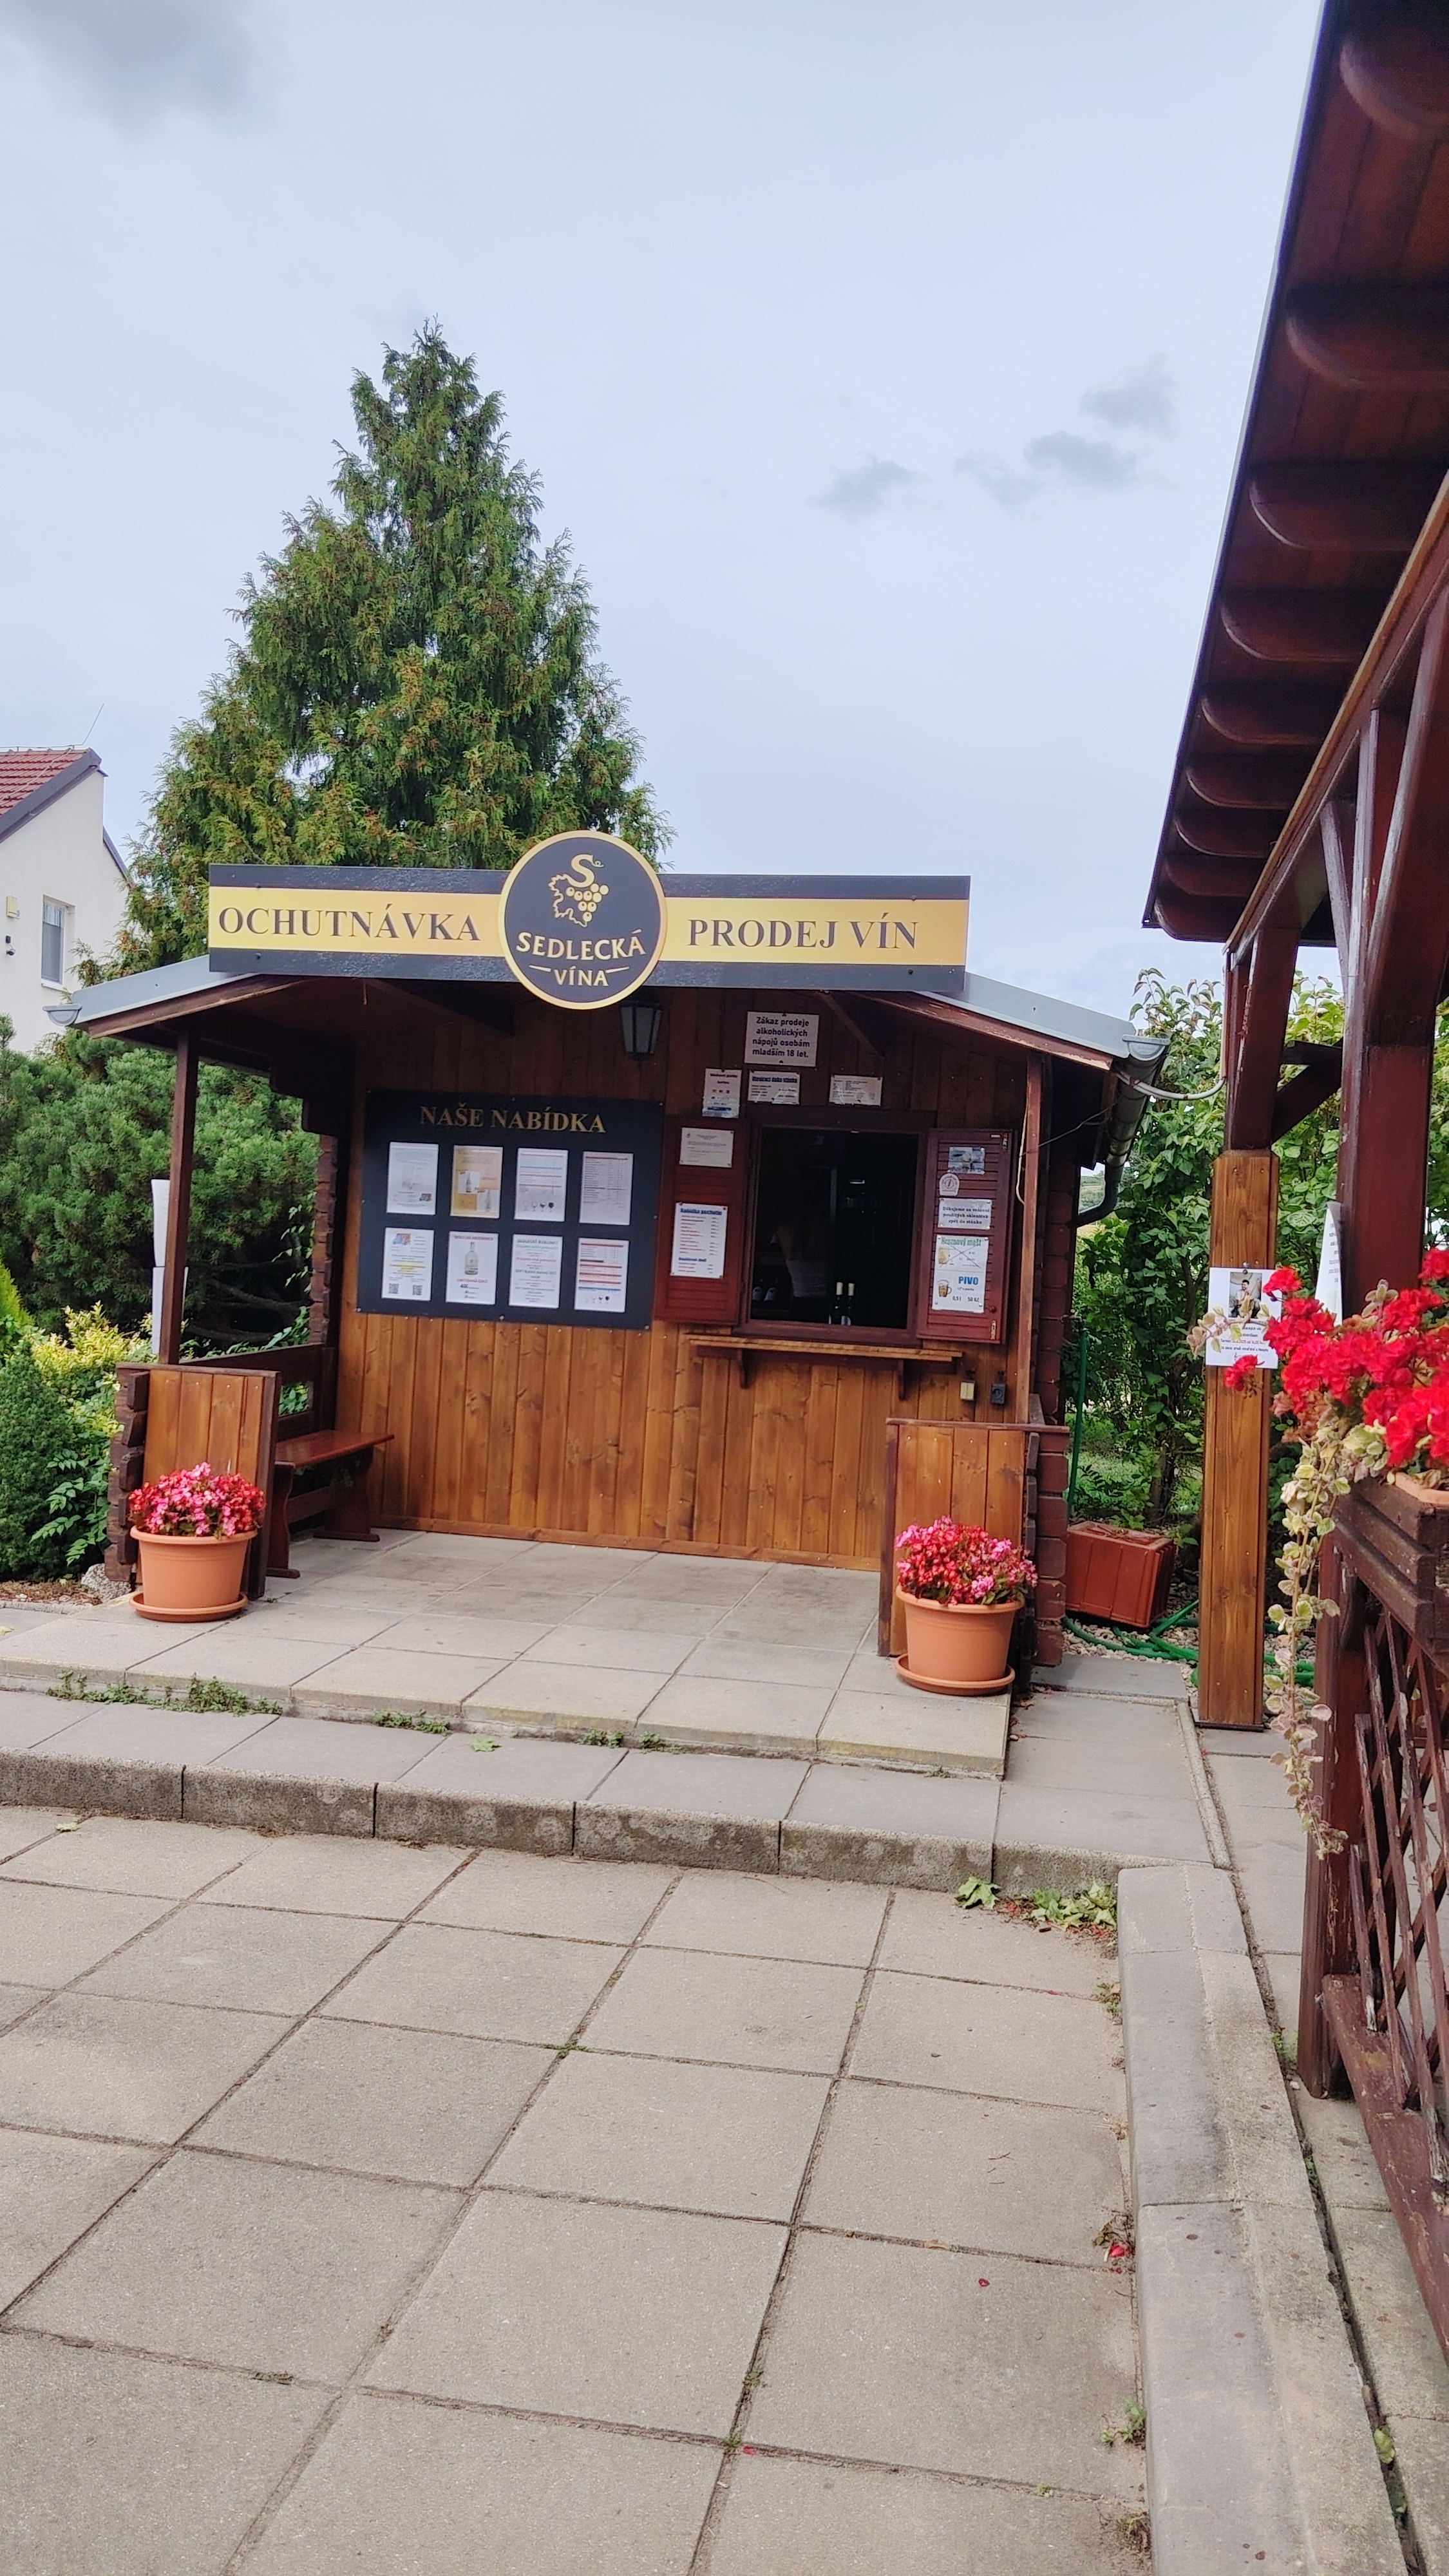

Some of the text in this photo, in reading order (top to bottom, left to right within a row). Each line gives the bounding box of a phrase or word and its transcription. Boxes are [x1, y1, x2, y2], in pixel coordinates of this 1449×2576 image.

[219, 904, 481, 941] OCHUTNÁVKA
[687, 912, 919, 949] PRODEJ VÍN
[516, 929, 646, 960] SEDLECKÁ
[554, 965, 609, 986] VÍNA
[756, 1016, 810, 1028] Zákaz prodeje
[756, 1027, 808, 1037] alkoholických
[752, 1037, 810, 1047] nápojů osobám
[752, 1048, 785, 1056] mladším
[420, 1102, 606, 1133] NAŠE NABÍDKA
[958, 1276, 979, 1285] PIVO
